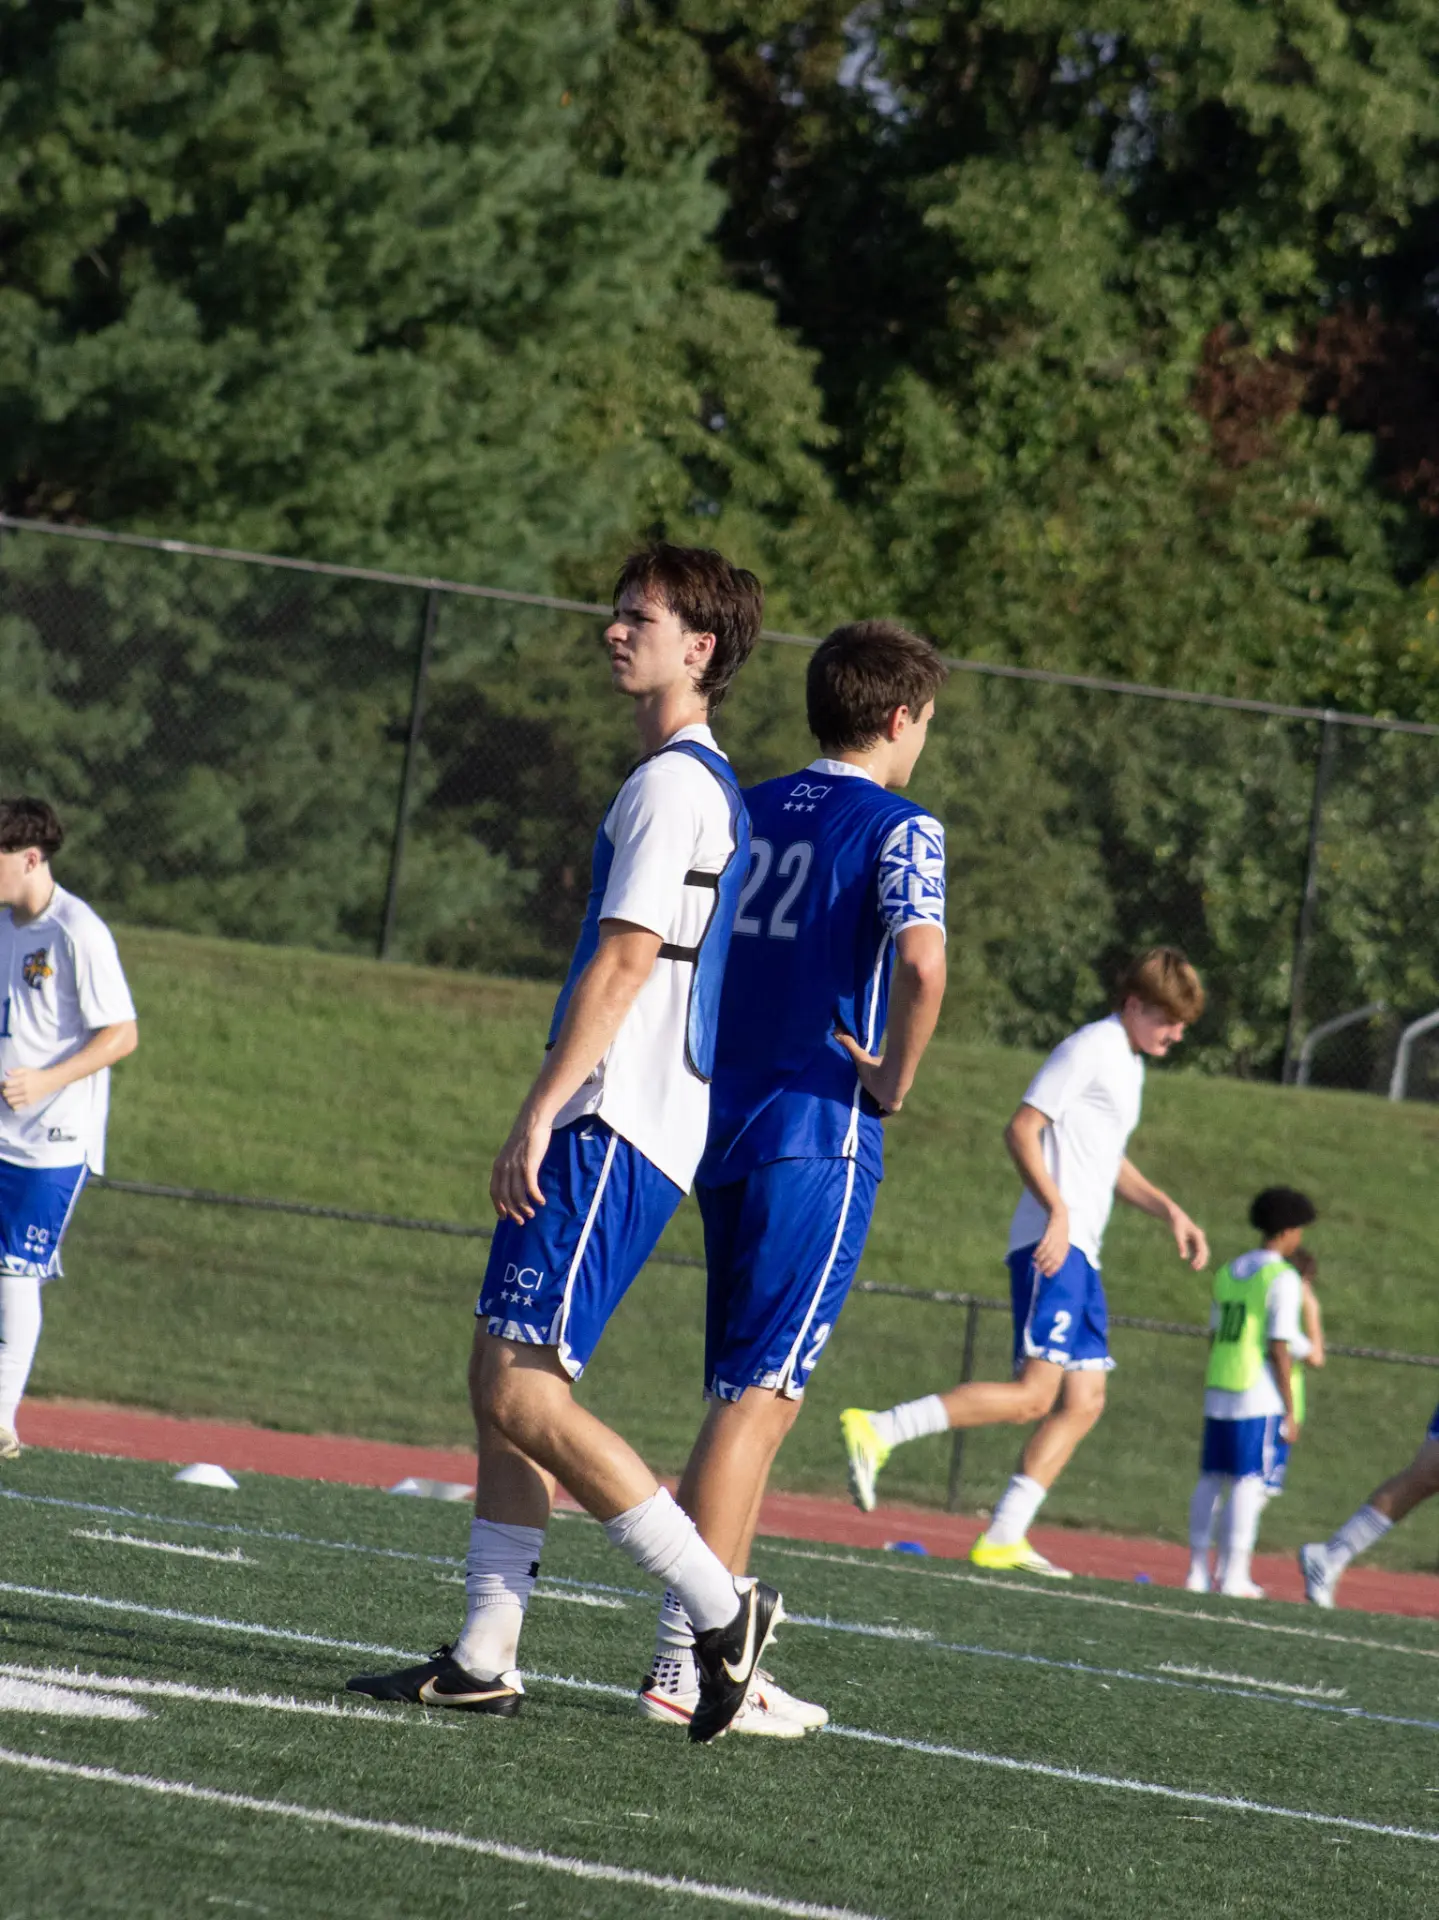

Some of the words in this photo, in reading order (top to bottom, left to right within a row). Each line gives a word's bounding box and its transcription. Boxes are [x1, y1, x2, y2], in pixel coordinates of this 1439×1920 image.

[790, 783, 834, 799] DCI
[732, 837, 815, 940] 22
[504, 1262, 544, 1291] DCI
[1050, 1310, 1072, 1344] 2
[801, 1322, 832, 1371] 2
